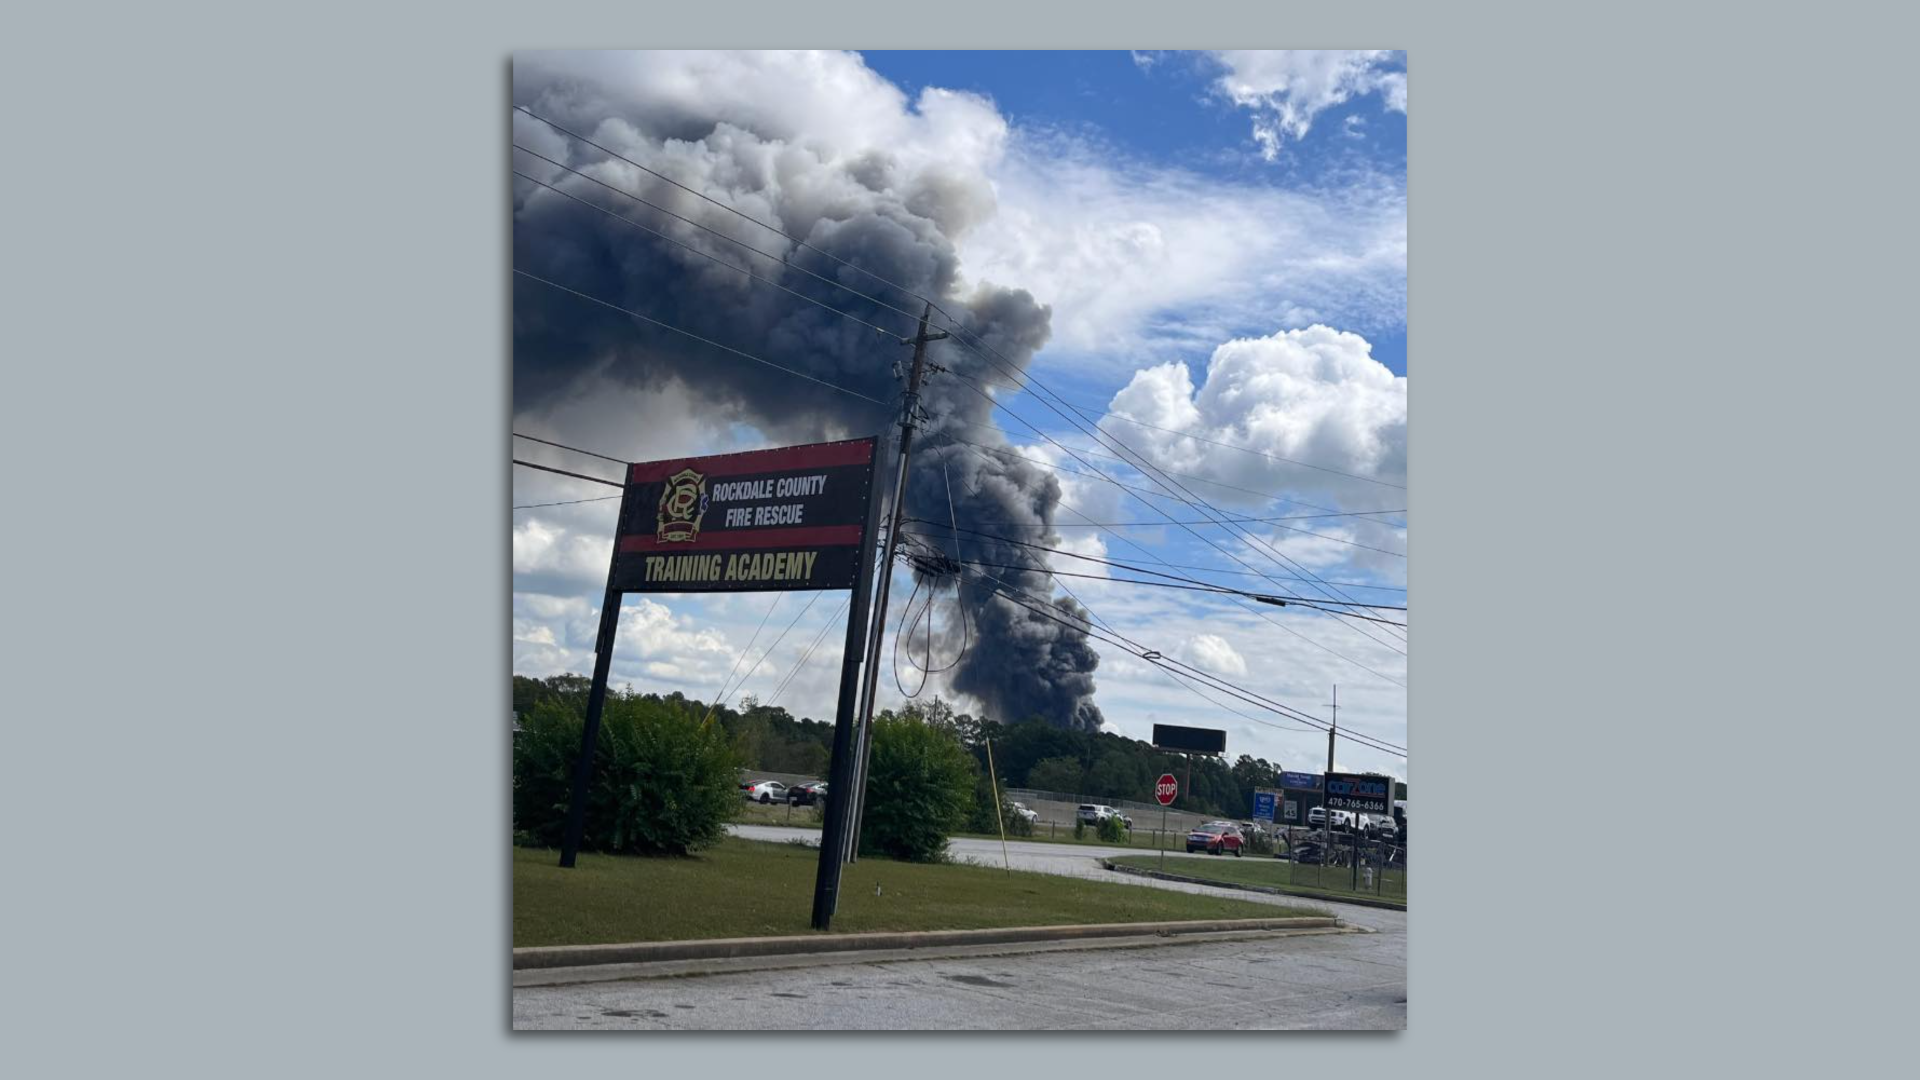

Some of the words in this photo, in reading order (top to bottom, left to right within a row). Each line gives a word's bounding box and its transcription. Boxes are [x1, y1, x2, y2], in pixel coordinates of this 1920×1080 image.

[712, 479, 773, 502] ROCKDALE
[776, 475, 827, 498] COUNTY
[725, 509, 752, 528] FIRE
[755, 504, 804, 526] RESCUE
[645, 554, 722, 582] TRAINING
[725, 551, 817, 581] ACADEMY
[1157, 783, 1176, 796] STOP
[1328, 796, 1384, 811] 470-765-6366
